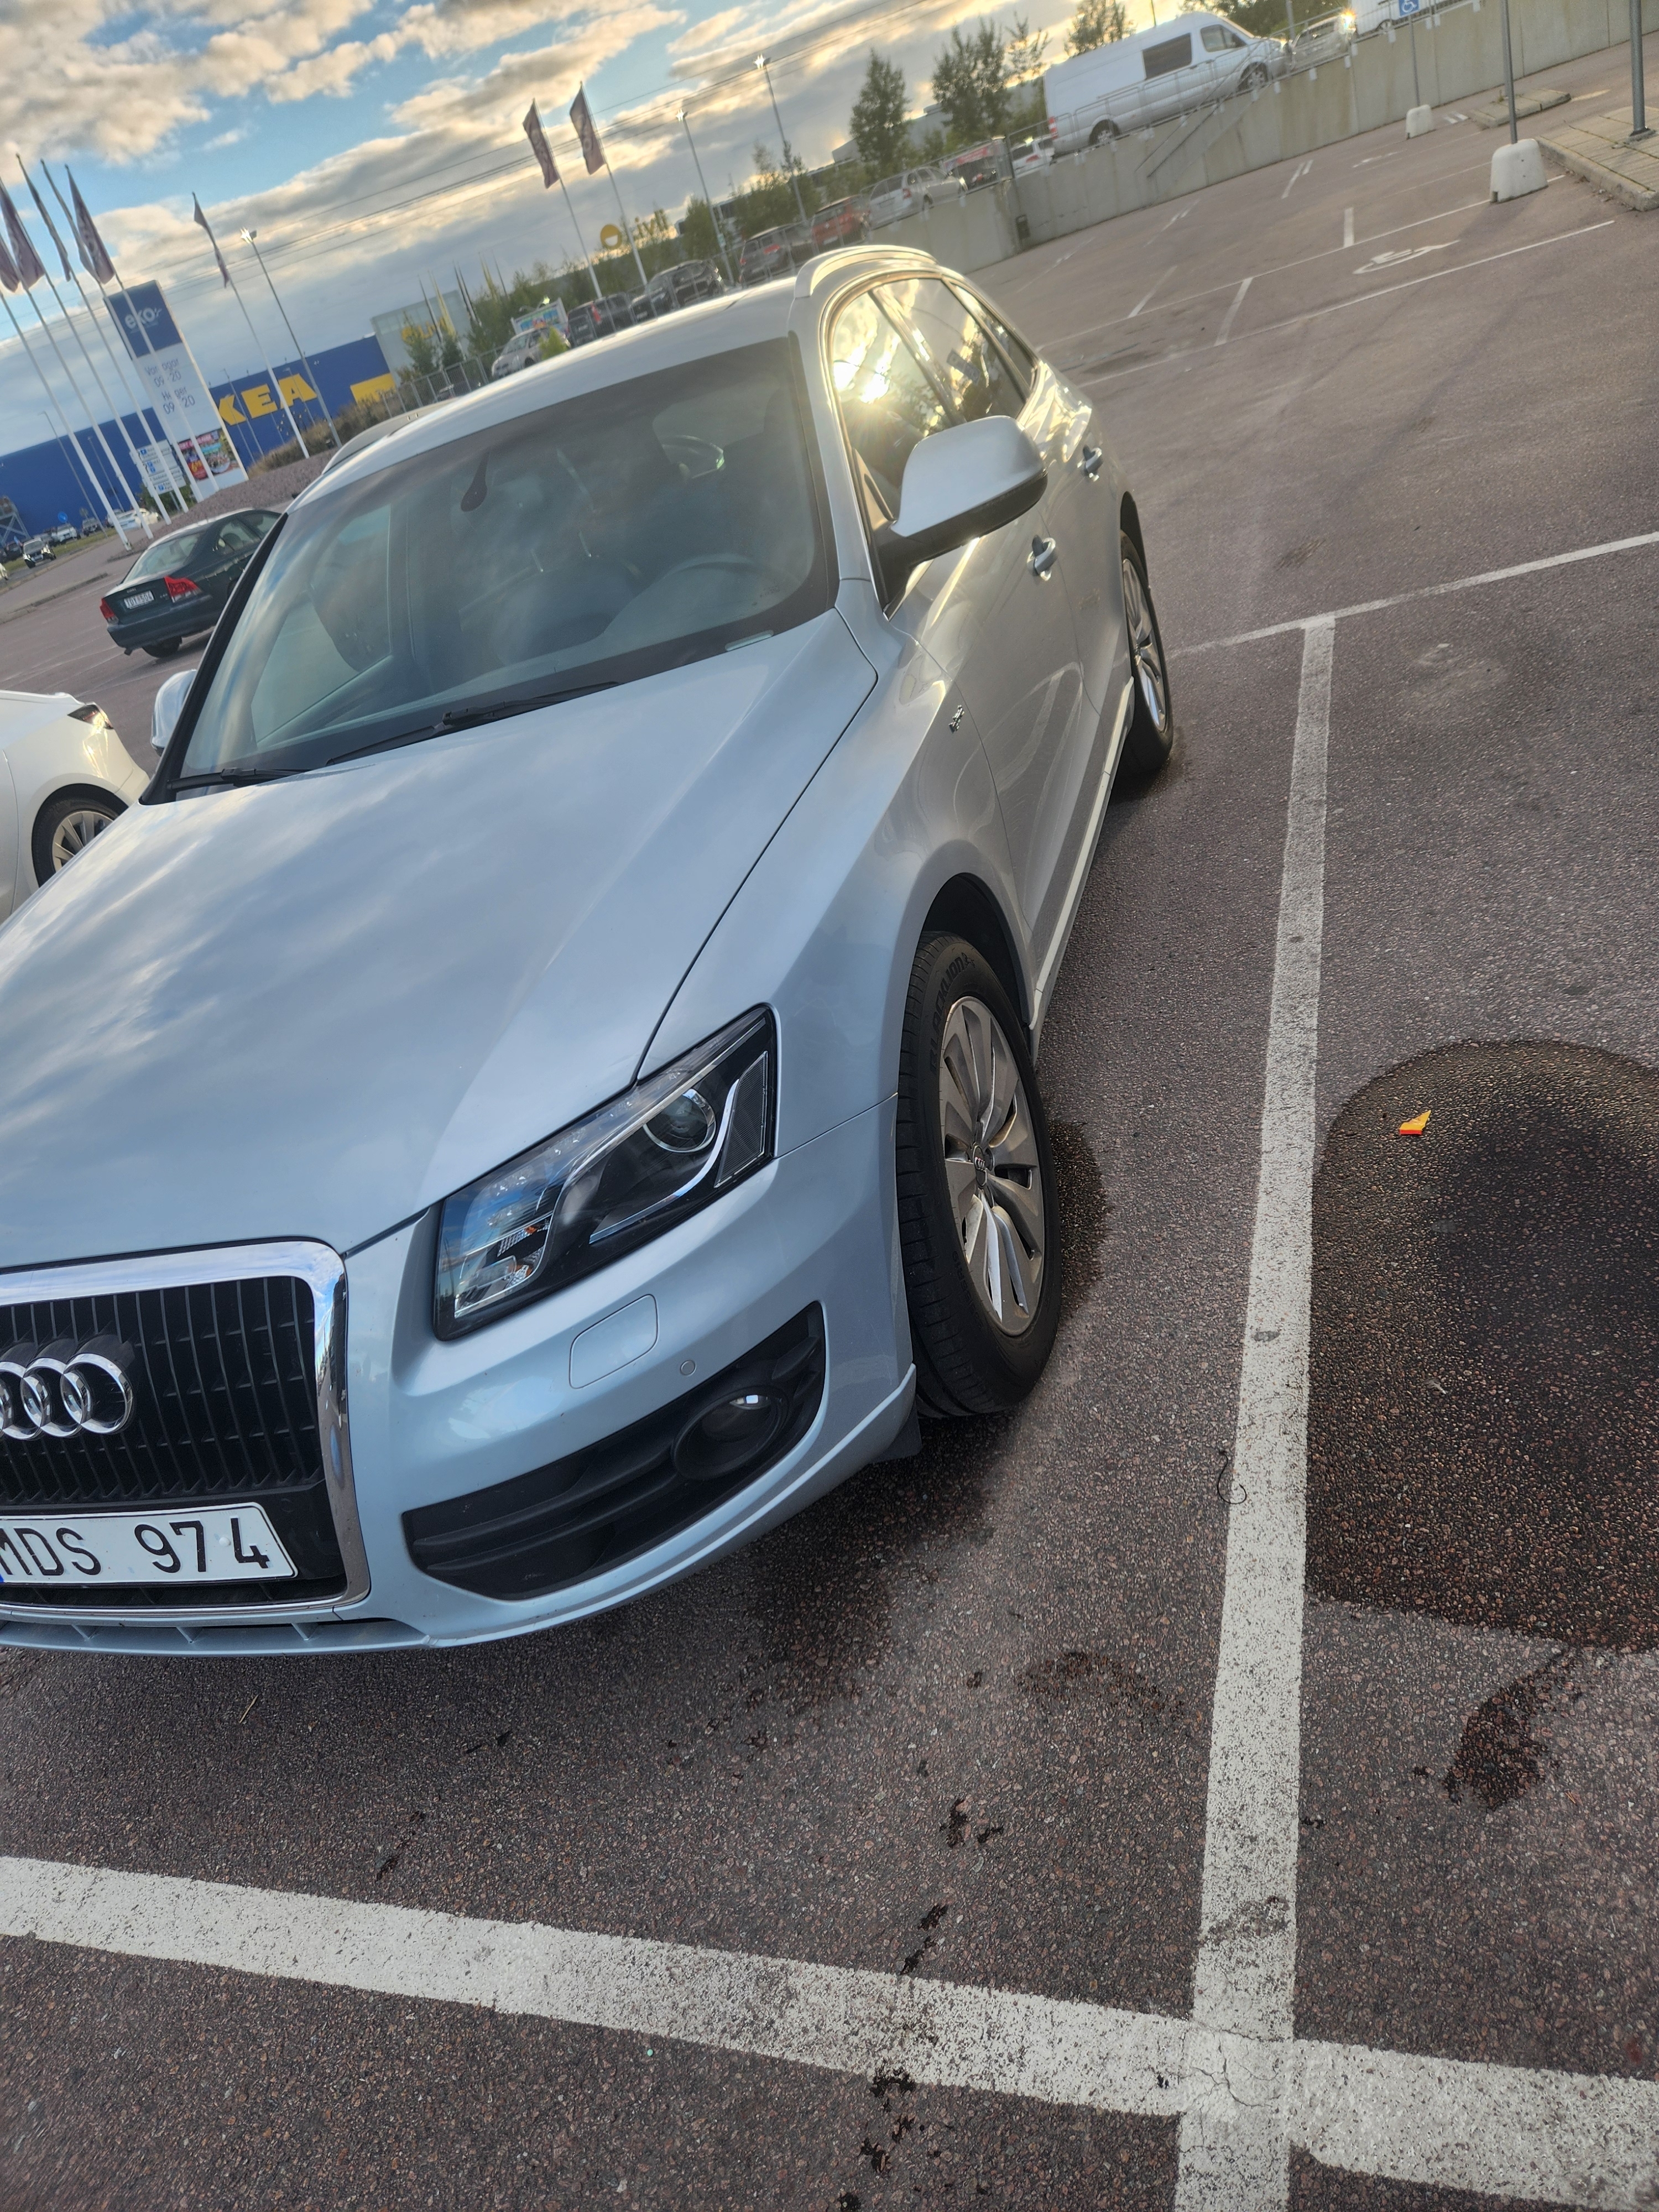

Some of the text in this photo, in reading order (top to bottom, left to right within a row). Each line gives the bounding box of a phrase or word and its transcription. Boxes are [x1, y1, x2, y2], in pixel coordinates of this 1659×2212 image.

[145, 359, 180, 376] Varagar
[161, 387, 187, 401] Heger
[218, 373, 317, 425] KEA
[929, 957, 964, 1074] BLACKLION
[0, 1517, 270, 1575] MDS 974
